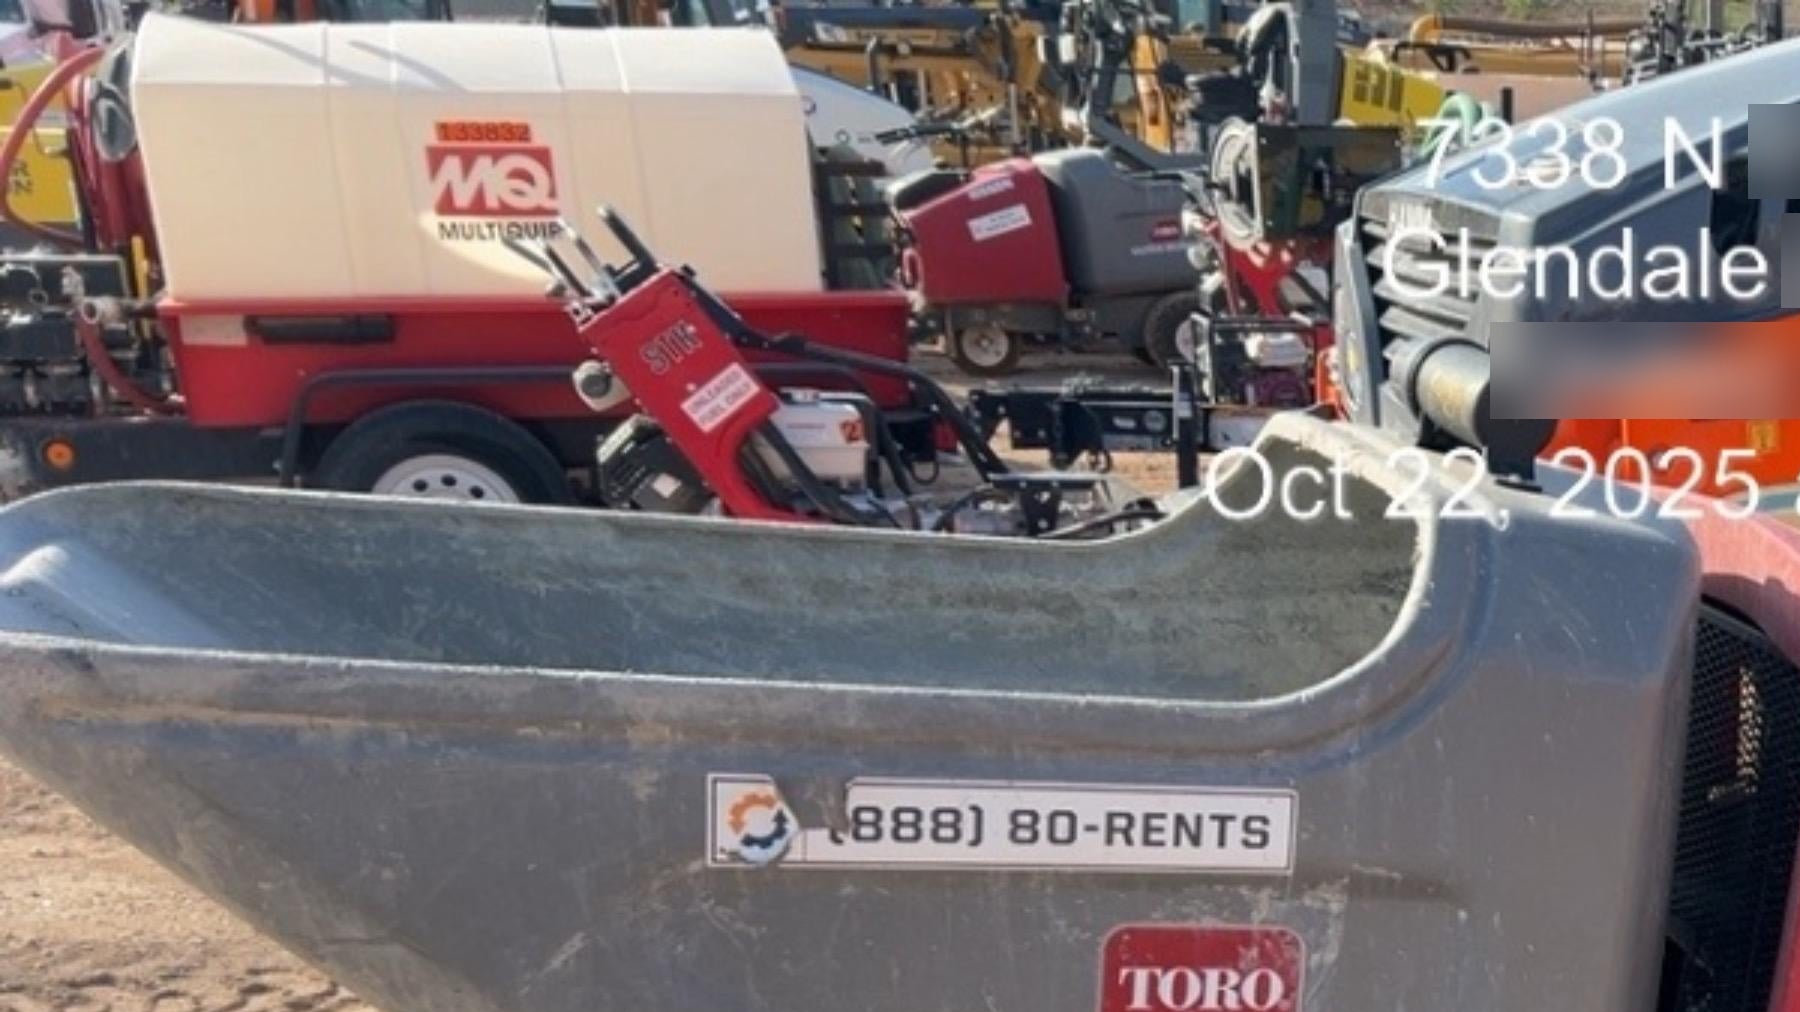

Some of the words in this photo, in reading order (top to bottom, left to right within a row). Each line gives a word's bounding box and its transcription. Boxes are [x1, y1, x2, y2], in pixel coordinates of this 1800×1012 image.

[431, 154, 557, 210] MQ
[438, 222, 564, 241] MULTIQUIP
[1007, 808, 1271, 850] 80-RENTS
[1118, 966, 1285, 1012] TORO
